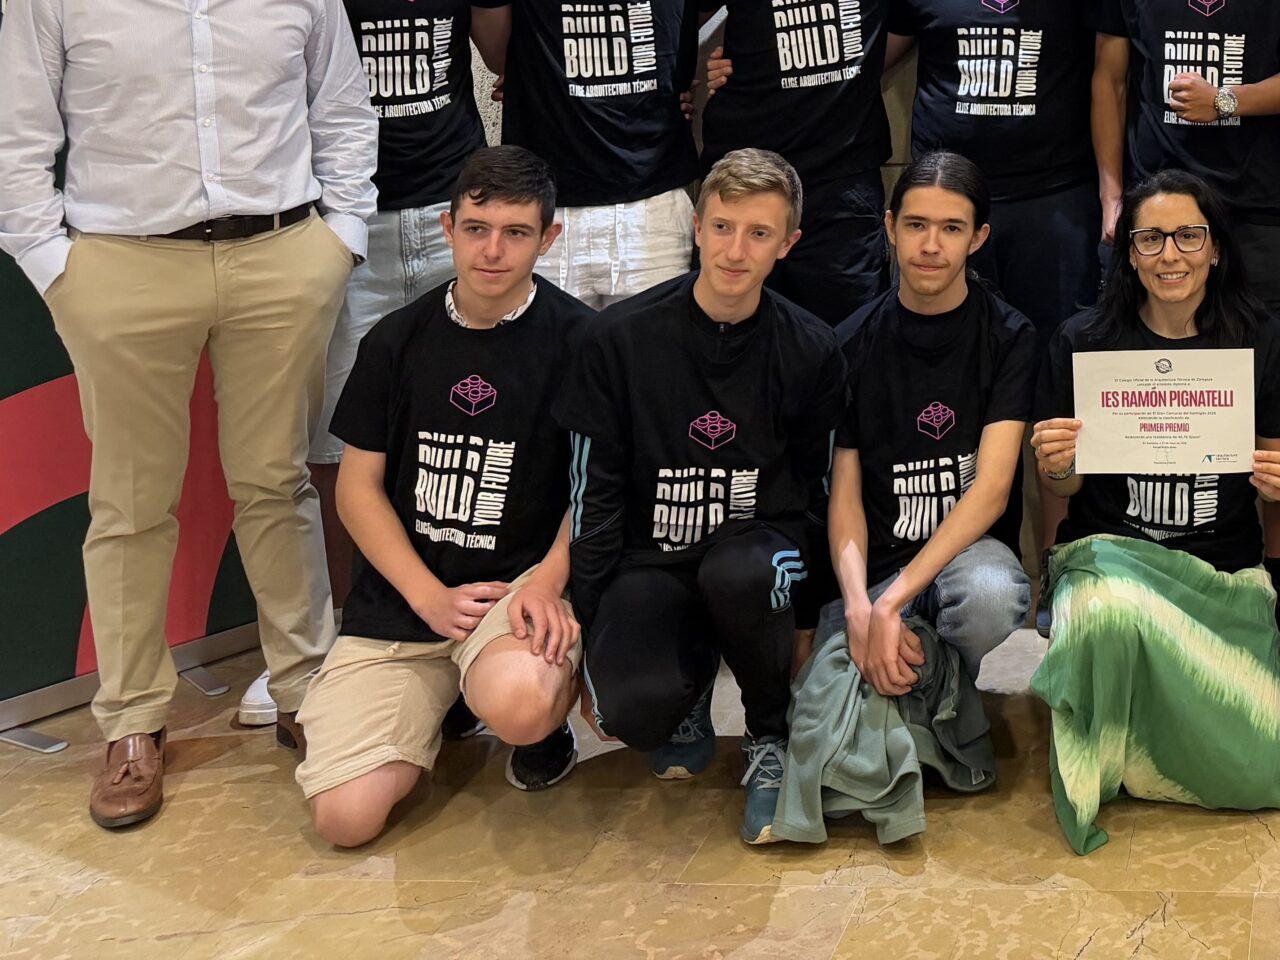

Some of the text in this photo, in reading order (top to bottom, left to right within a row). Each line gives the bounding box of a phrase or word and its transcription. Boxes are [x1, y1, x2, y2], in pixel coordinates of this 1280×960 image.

[432, 16, 454, 60] FUTURE
[627, 1, 657, 74] YOUR FUTURE
[776, 24, 840, 71] BUILD
[842, 29, 864, 61] YOUR
[1223, 33, 1246, 75] FUTURE
[362, 54, 431, 98] BUILD
[563, 37, 628, 78] BUILD
[1015, 29, 1043, 98] YOUR FUTURE
[585, 82, 631, 98] ARQUITECTURA
[632, 78, 657, 93] TÉCNICA
[800, 70, 842, 87] ARQUITECTURA
[957, 59, 1013, 97] BUILD
[385, 100, 434, 118] ARQUITECTURA
[970, 103, 1011, 116] ARQUITECTURA
[1012, 102, 1036, 116] TÉCNICA
[1101, 386, 1234, 408] IES RAMÓN PIGNATELLI
[1139, 422, 1190, 433] PRIMER PREMIO
[415, 467, 475, 522] BUILD
[472, 439, 516, 526] YOUR FUTURE
[1126, 476, 1189, 526] BUILD
[1193, 490, 1218, 527] YOUR
[466, 532, 496, 550] TÉCNICA
